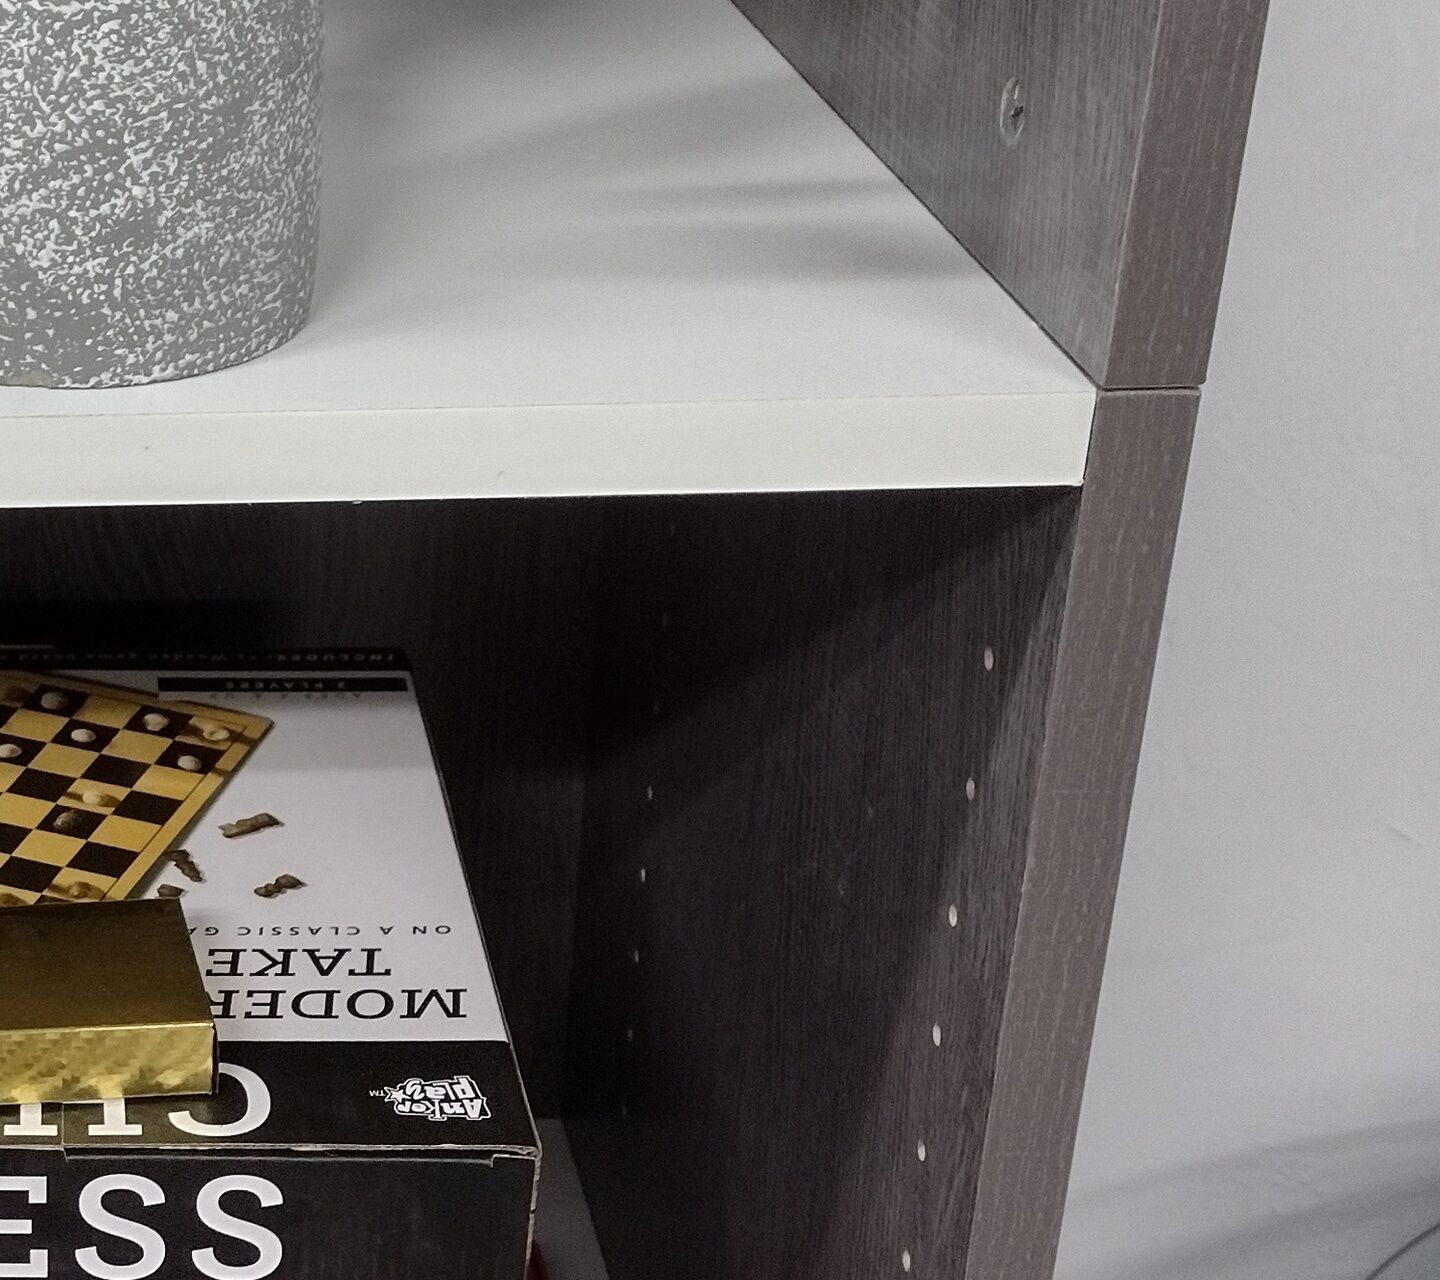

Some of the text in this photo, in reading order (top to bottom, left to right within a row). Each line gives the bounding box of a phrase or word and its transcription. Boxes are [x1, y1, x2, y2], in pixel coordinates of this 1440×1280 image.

[237, 925, 451, 936] ON A CLASSIC
[205, 948, 392, 976] TAKE
